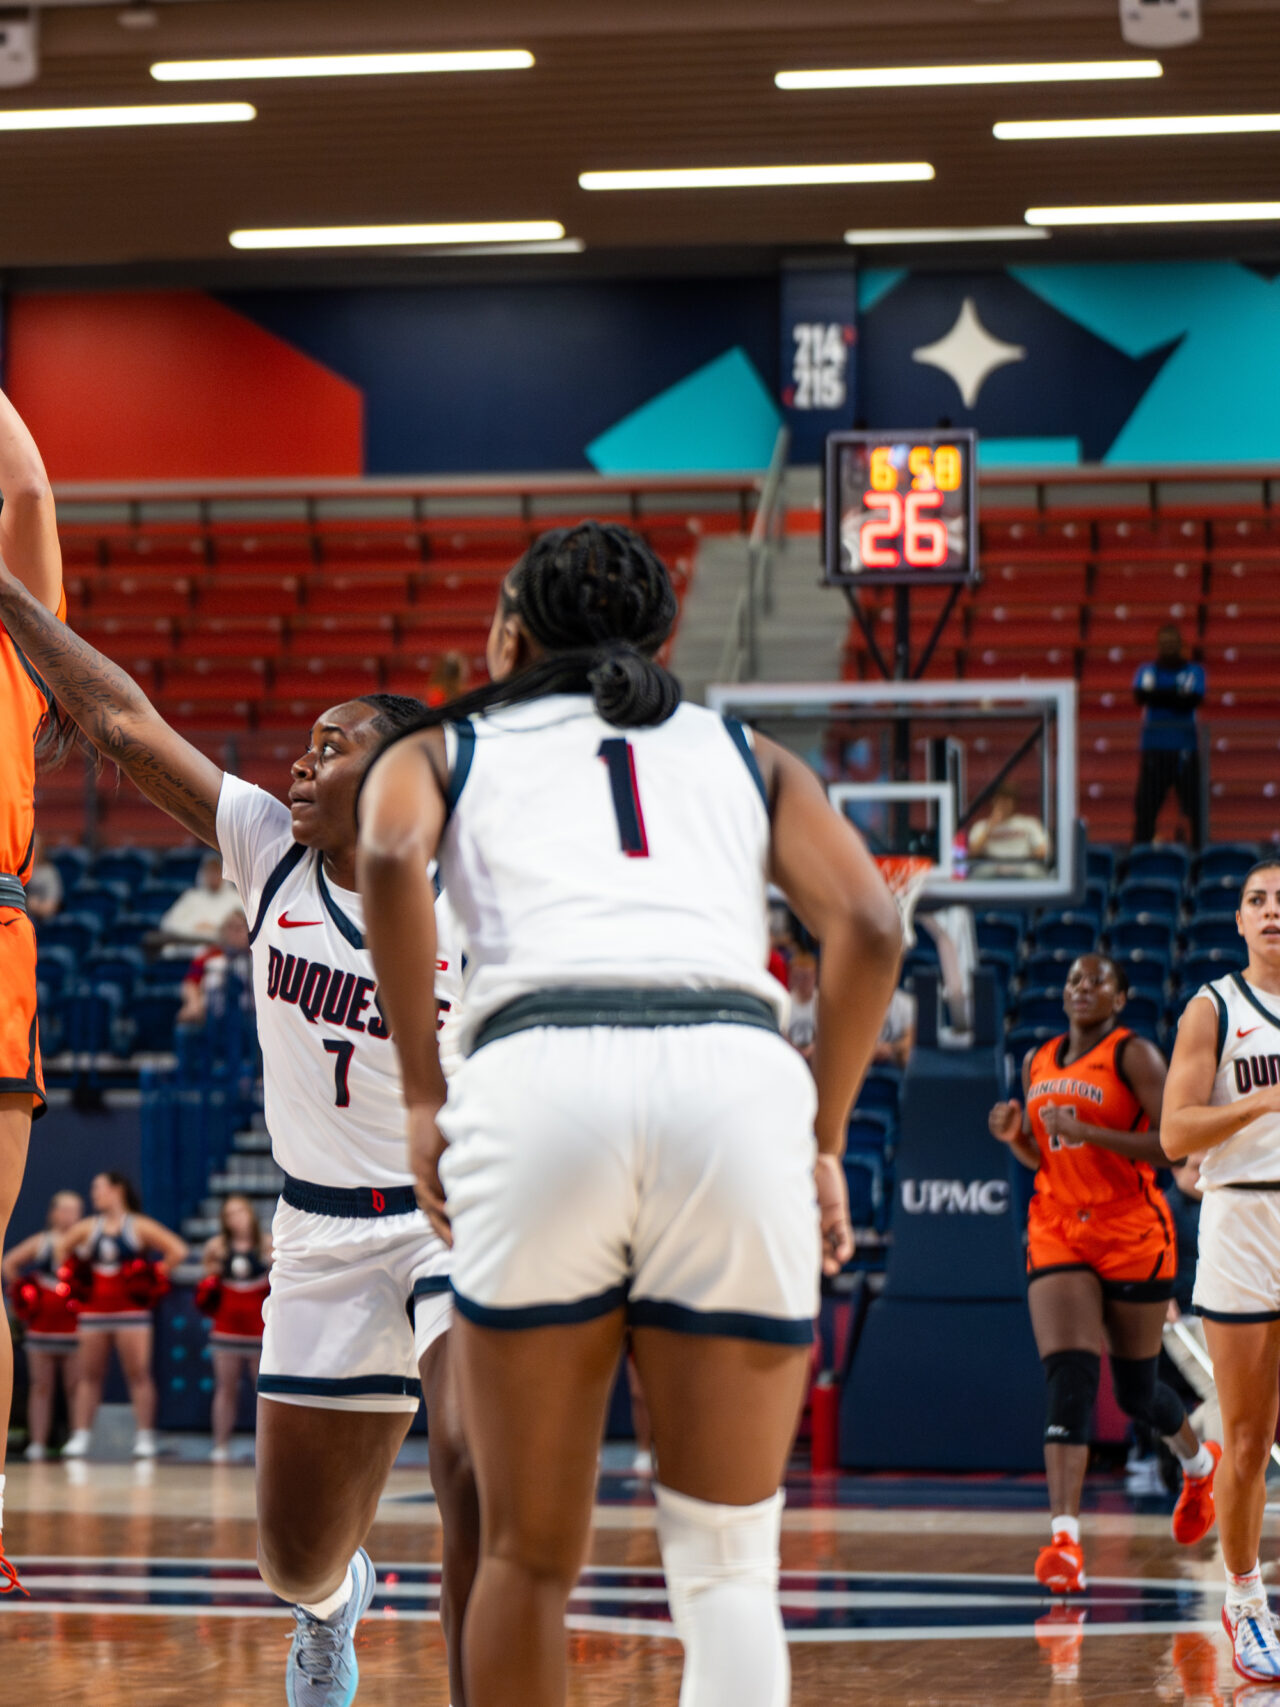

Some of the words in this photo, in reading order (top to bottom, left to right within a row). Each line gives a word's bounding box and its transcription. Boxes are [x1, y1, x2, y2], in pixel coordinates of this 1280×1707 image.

[792, 322, 847, 366] 214
[859, 489, 948, 568] 26
[597, 738, 650, 858] 1
[267, 945, 452, 1041] DUQUES
[322, 1038, 356, 1108] 7
[901, 1179, 1010, 1215] UPMC
